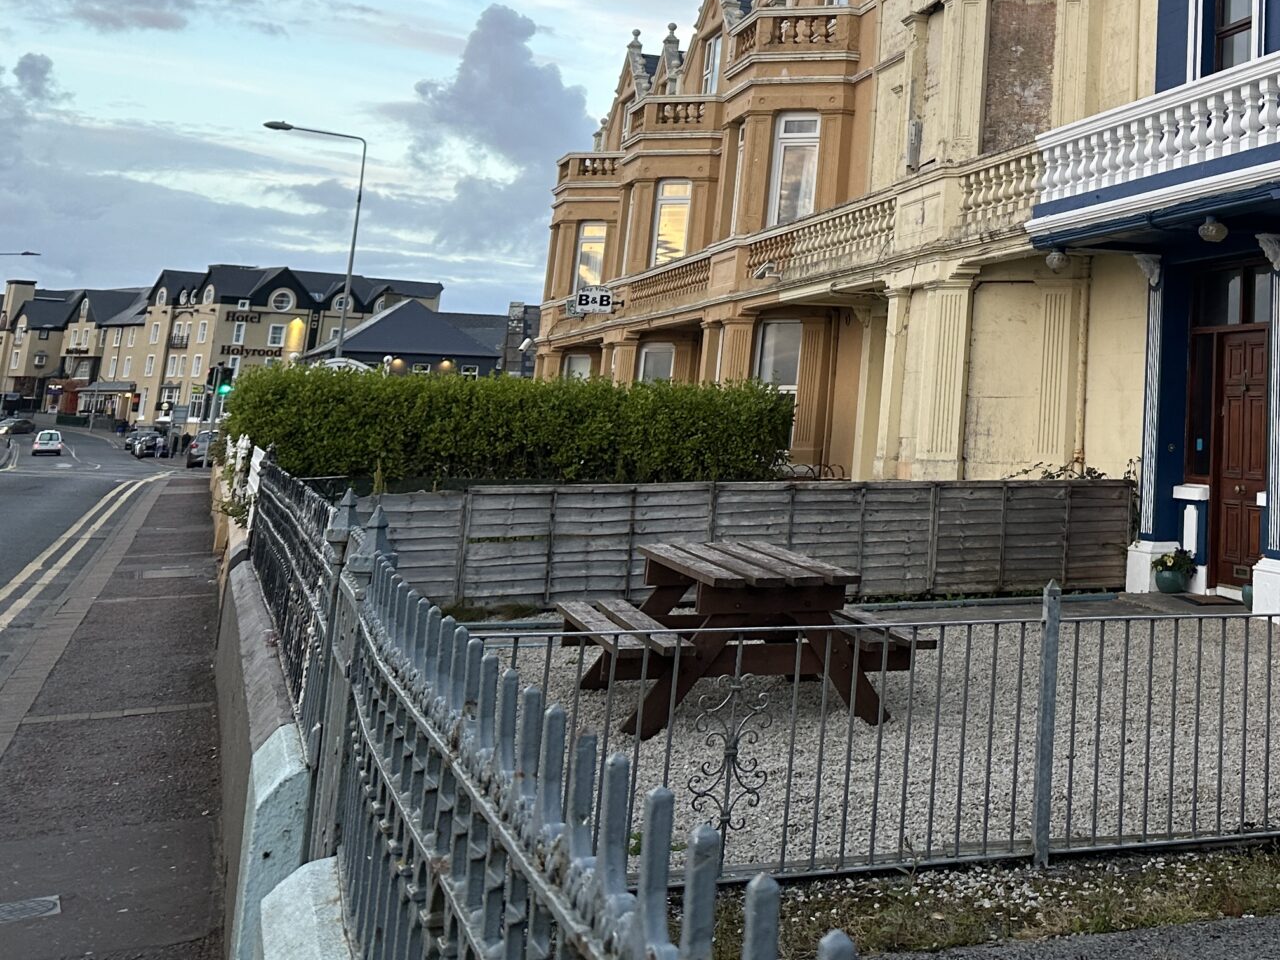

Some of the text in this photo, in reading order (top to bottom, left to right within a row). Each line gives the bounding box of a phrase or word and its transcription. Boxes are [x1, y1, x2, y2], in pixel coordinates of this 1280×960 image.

[579, 294, 611, 306] B&B
[225, 311, 261, 323] Hotel
[220, 345, 283, 358] Holyrood
